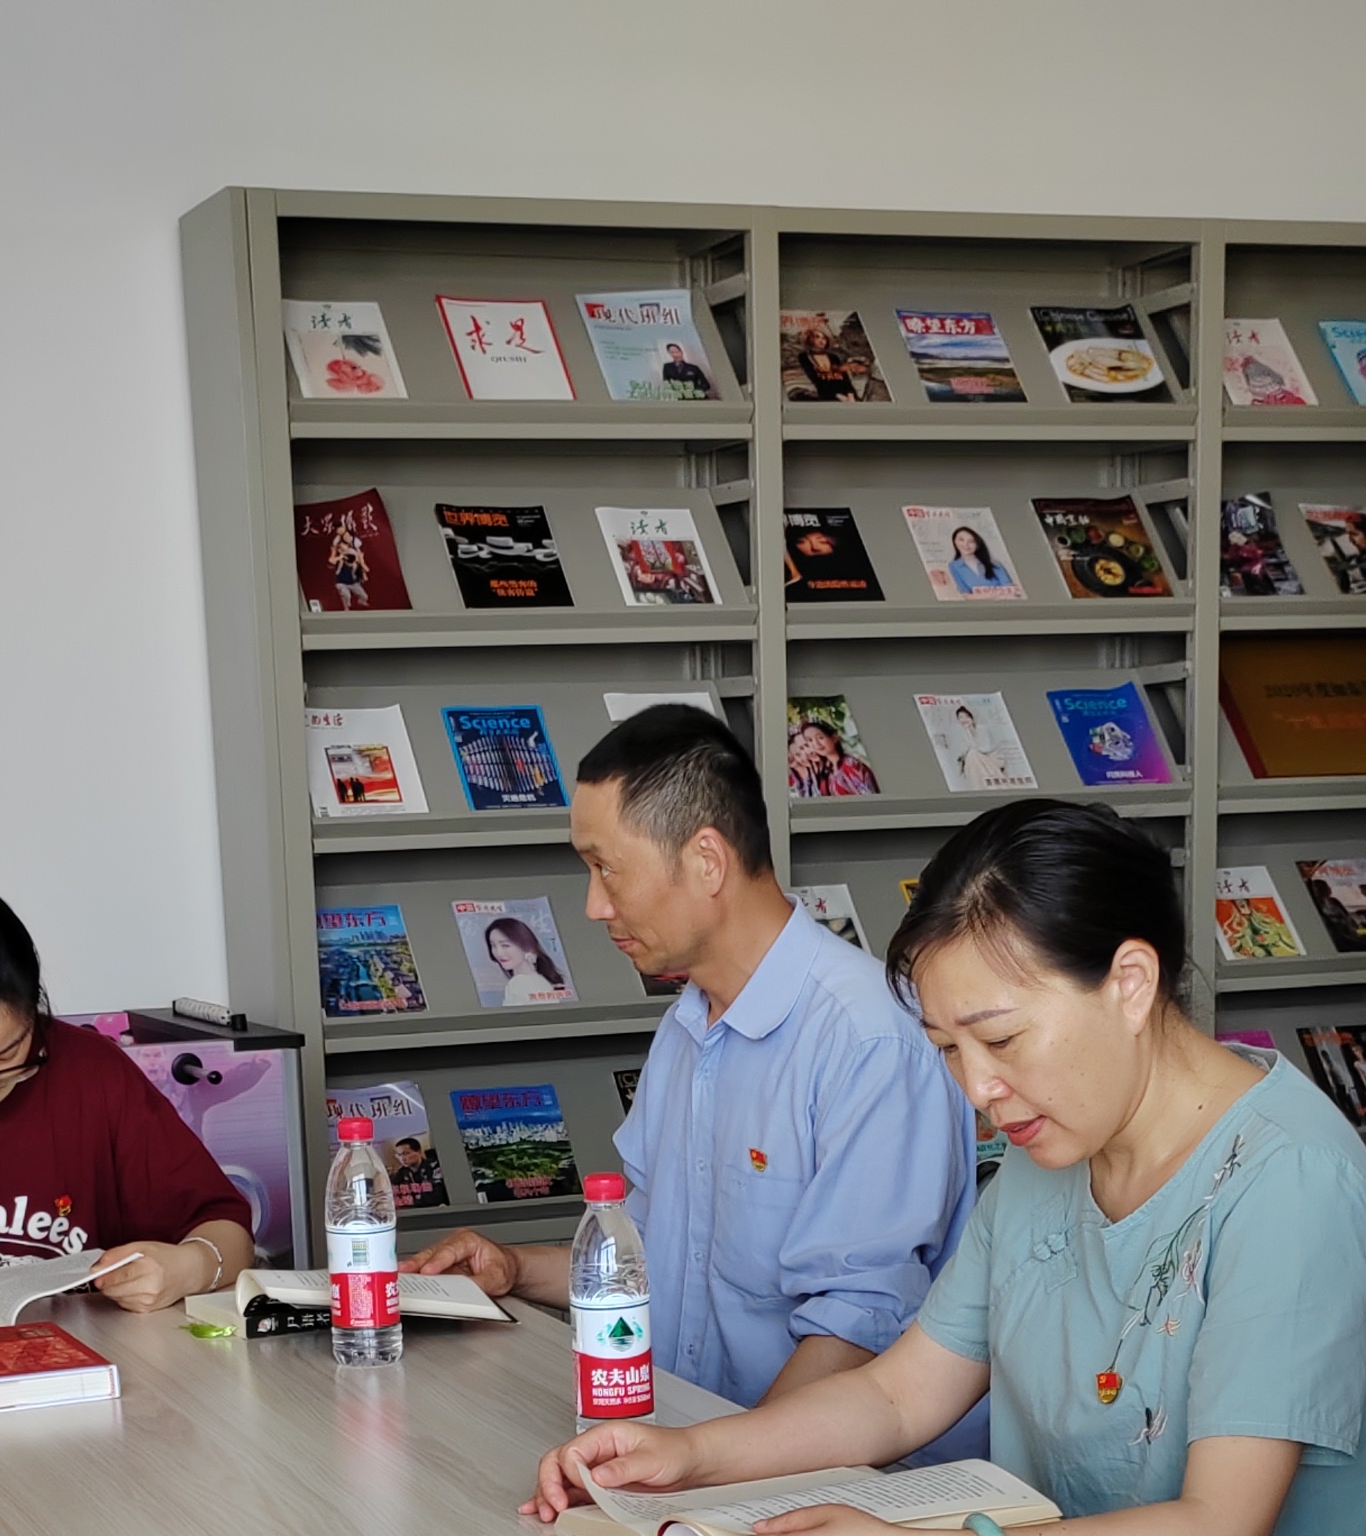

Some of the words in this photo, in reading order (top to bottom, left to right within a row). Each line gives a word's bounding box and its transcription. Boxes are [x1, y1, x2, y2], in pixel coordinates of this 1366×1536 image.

[310, 312, 354, 330] 读者
[593, 304, 682, 326] 现代班组
[464, 314, 546, 355] 求是
[442, 510, 510, 528] 世界博览
[784, 513, 822, 527] 博览
[629, 520, 669, 537] 读者
[1064, 698, 1128, 710] Science
[305, 713, 345, 728] 的生活
[460, 715, 532, 730] Science
[591, 1366, 651, 1387] 农夫山泉
[592, 1386, 625, 1398] NONGFU
